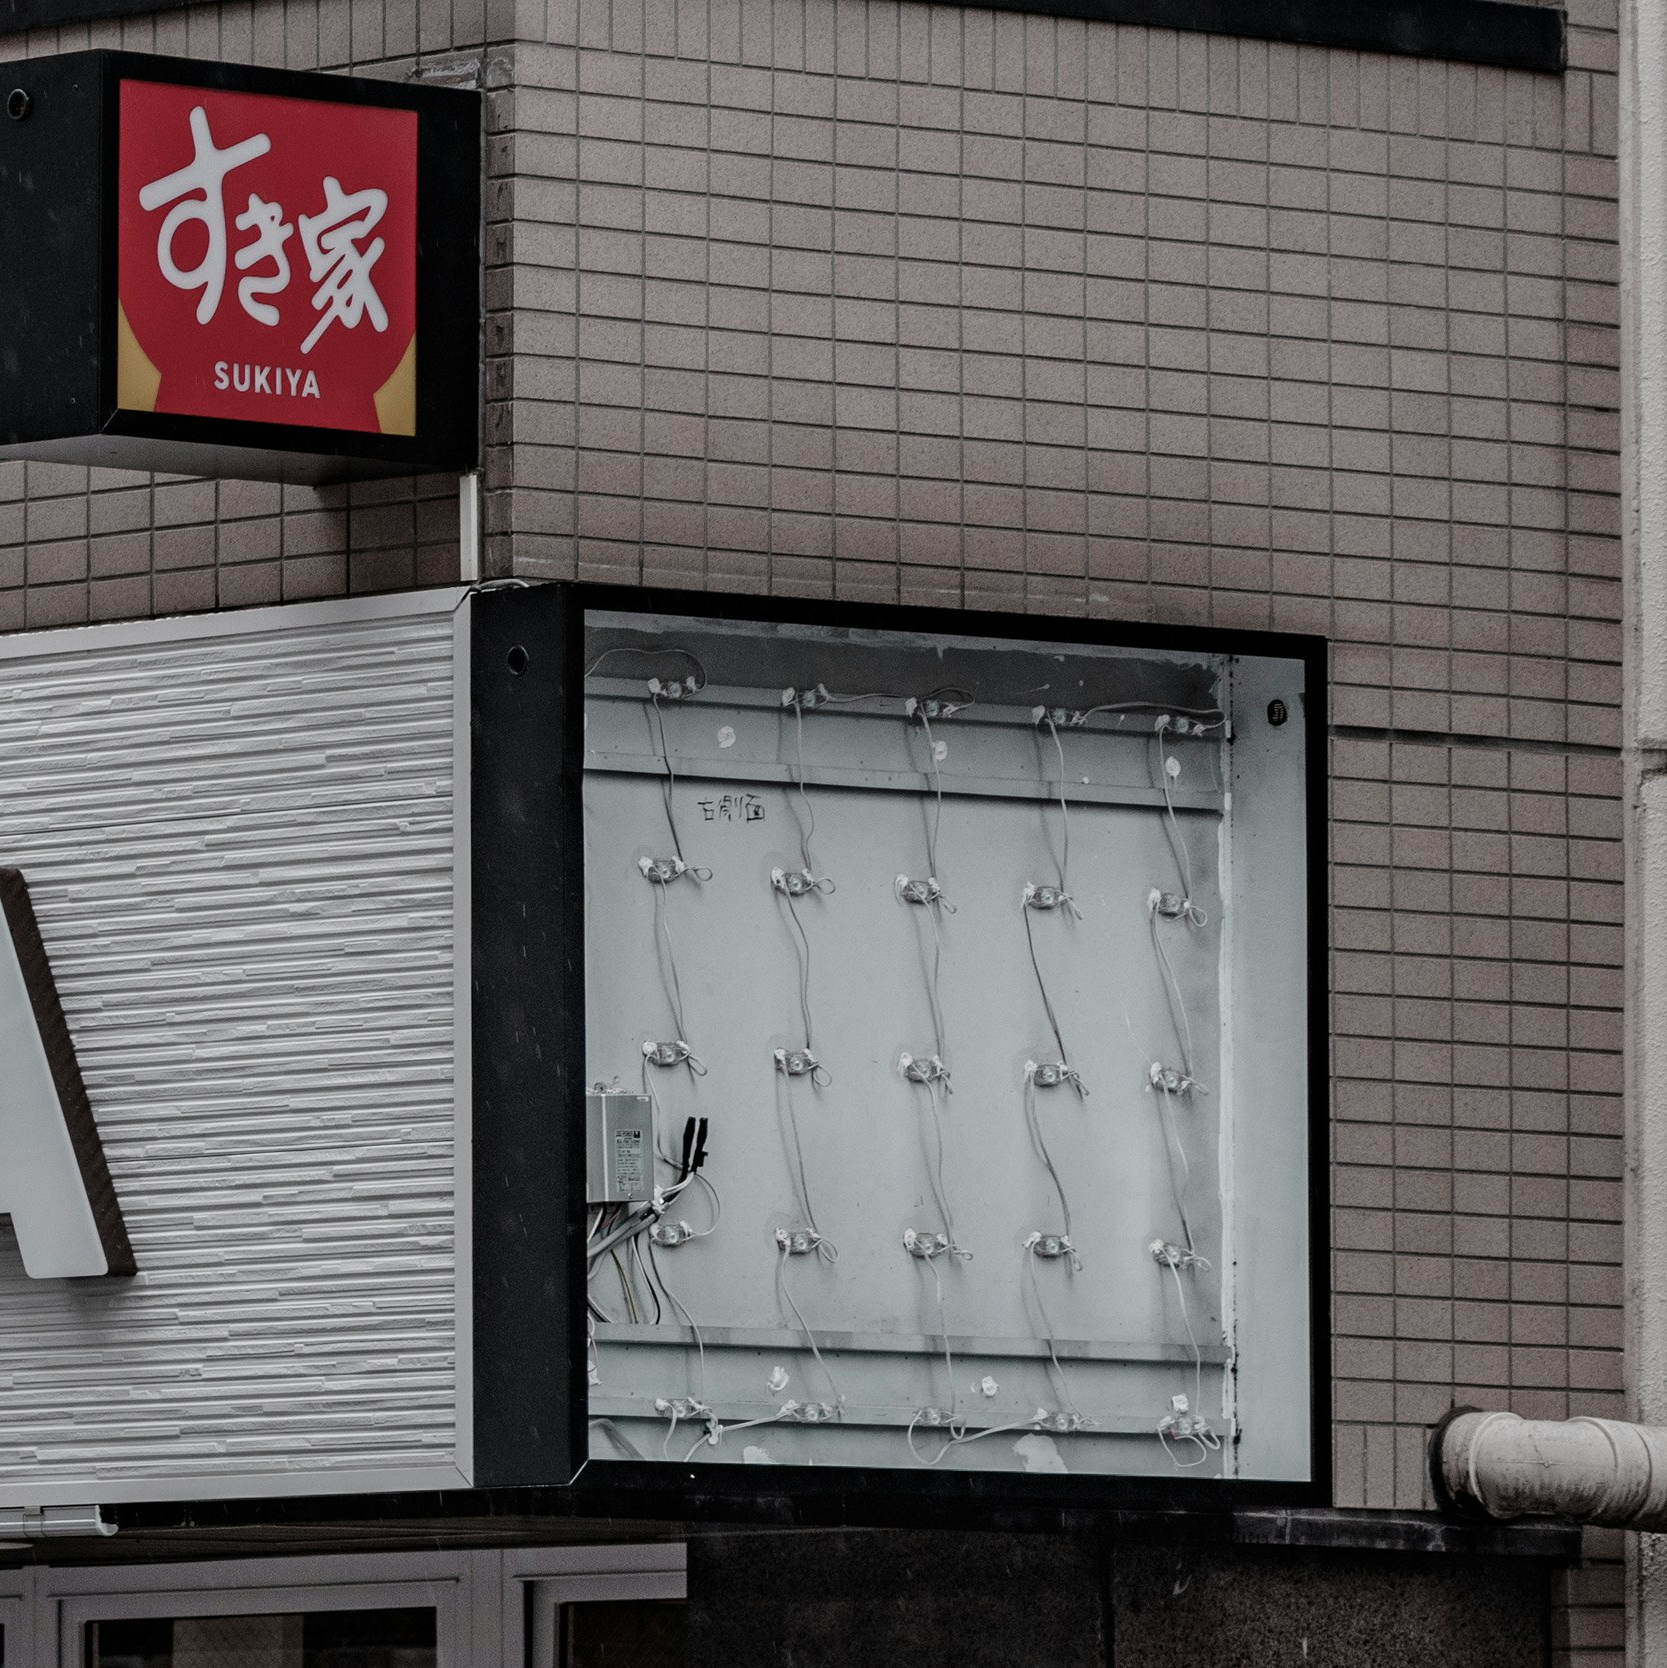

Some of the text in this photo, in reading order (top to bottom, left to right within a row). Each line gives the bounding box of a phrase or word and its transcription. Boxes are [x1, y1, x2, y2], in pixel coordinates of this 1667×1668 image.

[139, 106, 388, 354] すき家
[213, 360, 321, 399] SUKIYA
